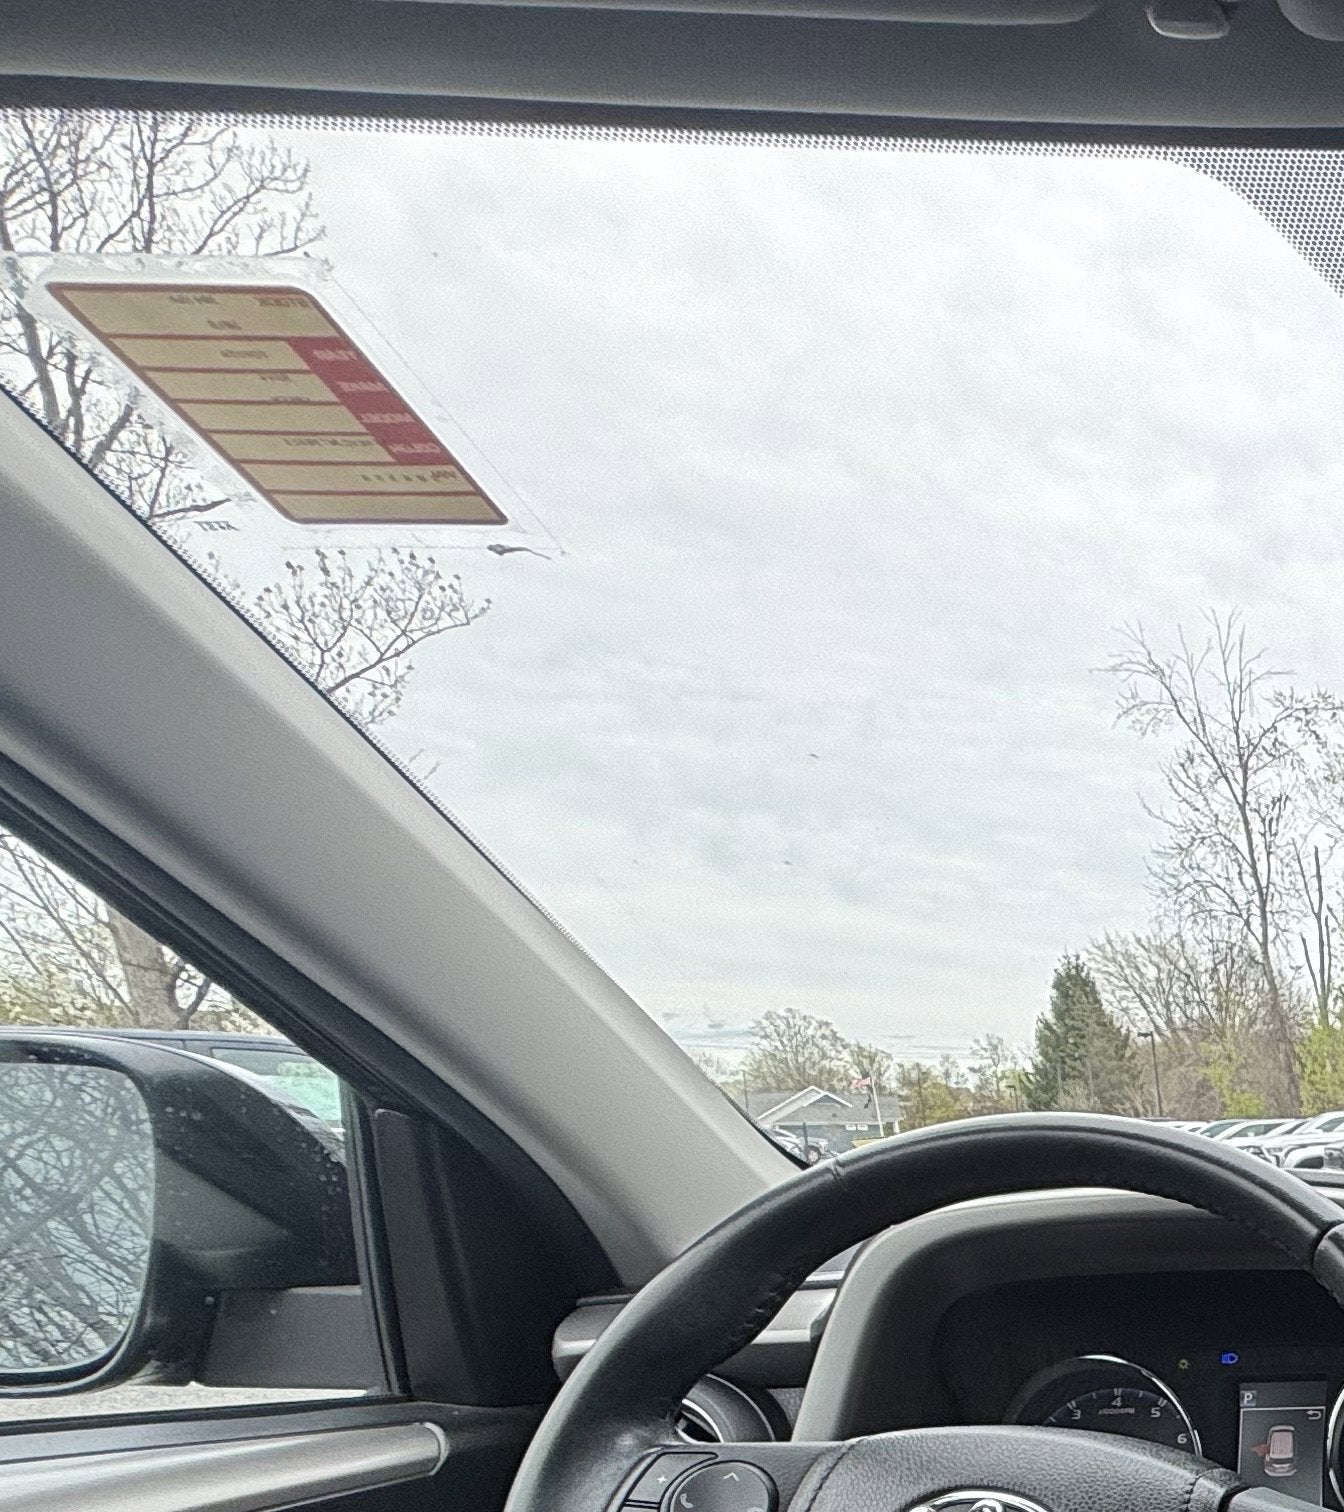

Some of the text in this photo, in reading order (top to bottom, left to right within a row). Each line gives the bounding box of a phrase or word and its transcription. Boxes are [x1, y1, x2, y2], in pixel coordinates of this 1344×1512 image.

[1111, 1397, 1122, 1407] 4
[1243, 1391, 1253, 1404] P
[1071, 1409, 1082, 1420] 3
[1150, 1406, 1161, 1418] 5
[1177, 1433, 1188, 1444] 6
